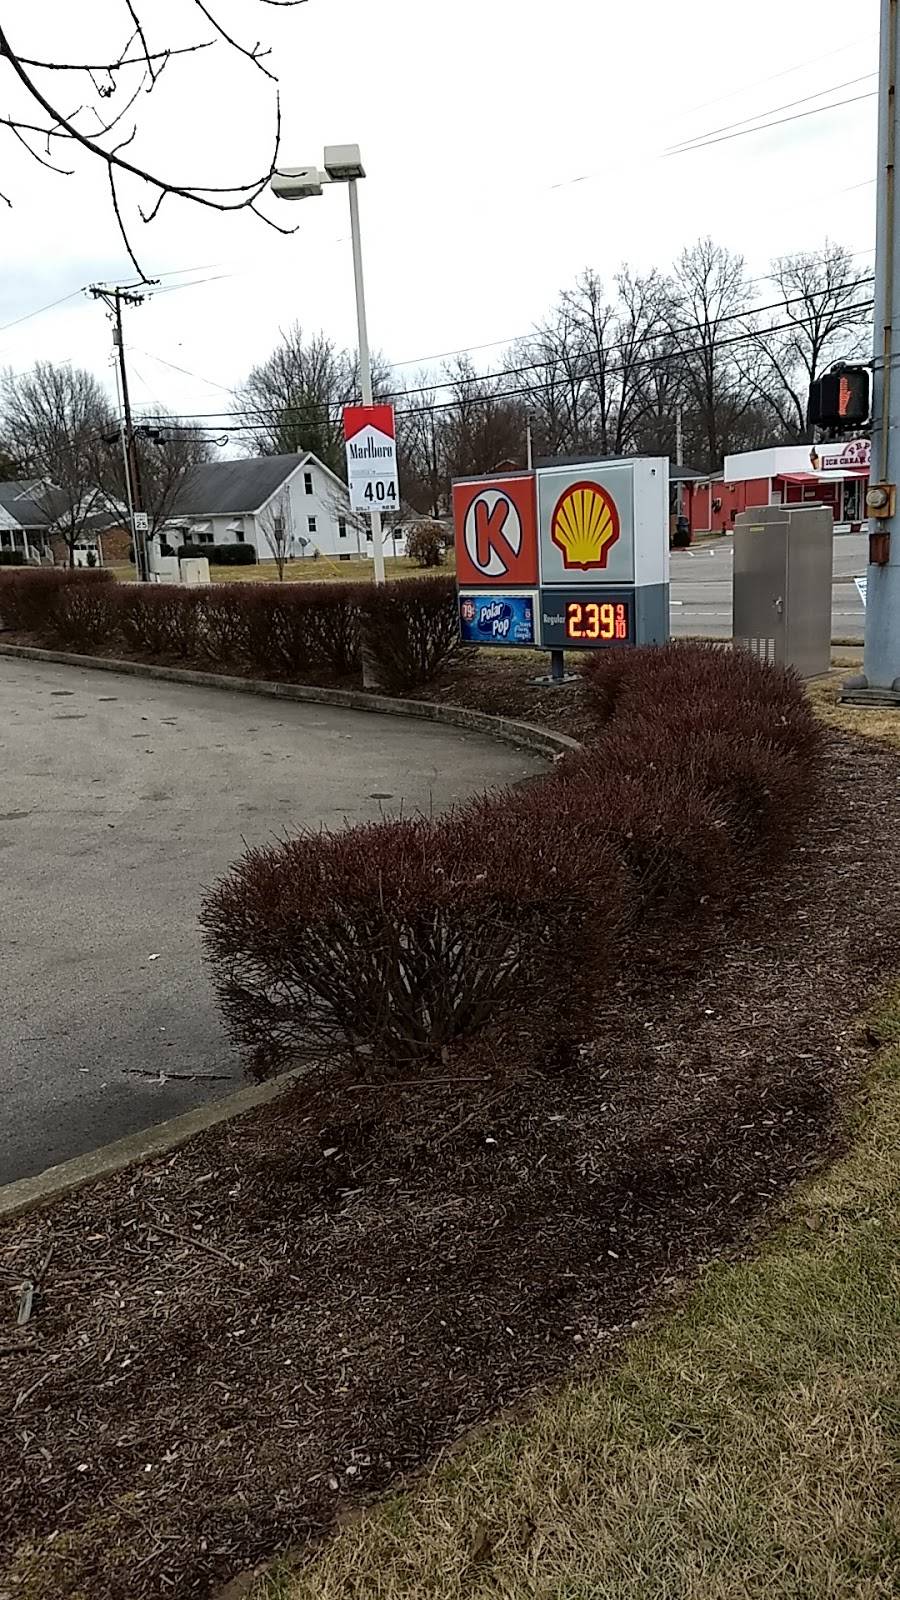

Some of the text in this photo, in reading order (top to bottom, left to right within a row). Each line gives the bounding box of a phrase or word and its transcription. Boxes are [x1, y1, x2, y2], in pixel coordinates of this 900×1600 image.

[350, 436, 393, 459] Marlboro
[825, 458, 838, 466] ICE
[840, 456, 867, 465] CREAM
[474, 498, 520, 568] K
[480, 602, 504, 622] Polar
[543, 613, 566, 626] Regular
[568, 603, 625, 638] 2.39 9
[492, 618, 510, 636] Pop
[616, 620, 626, 638] 10
